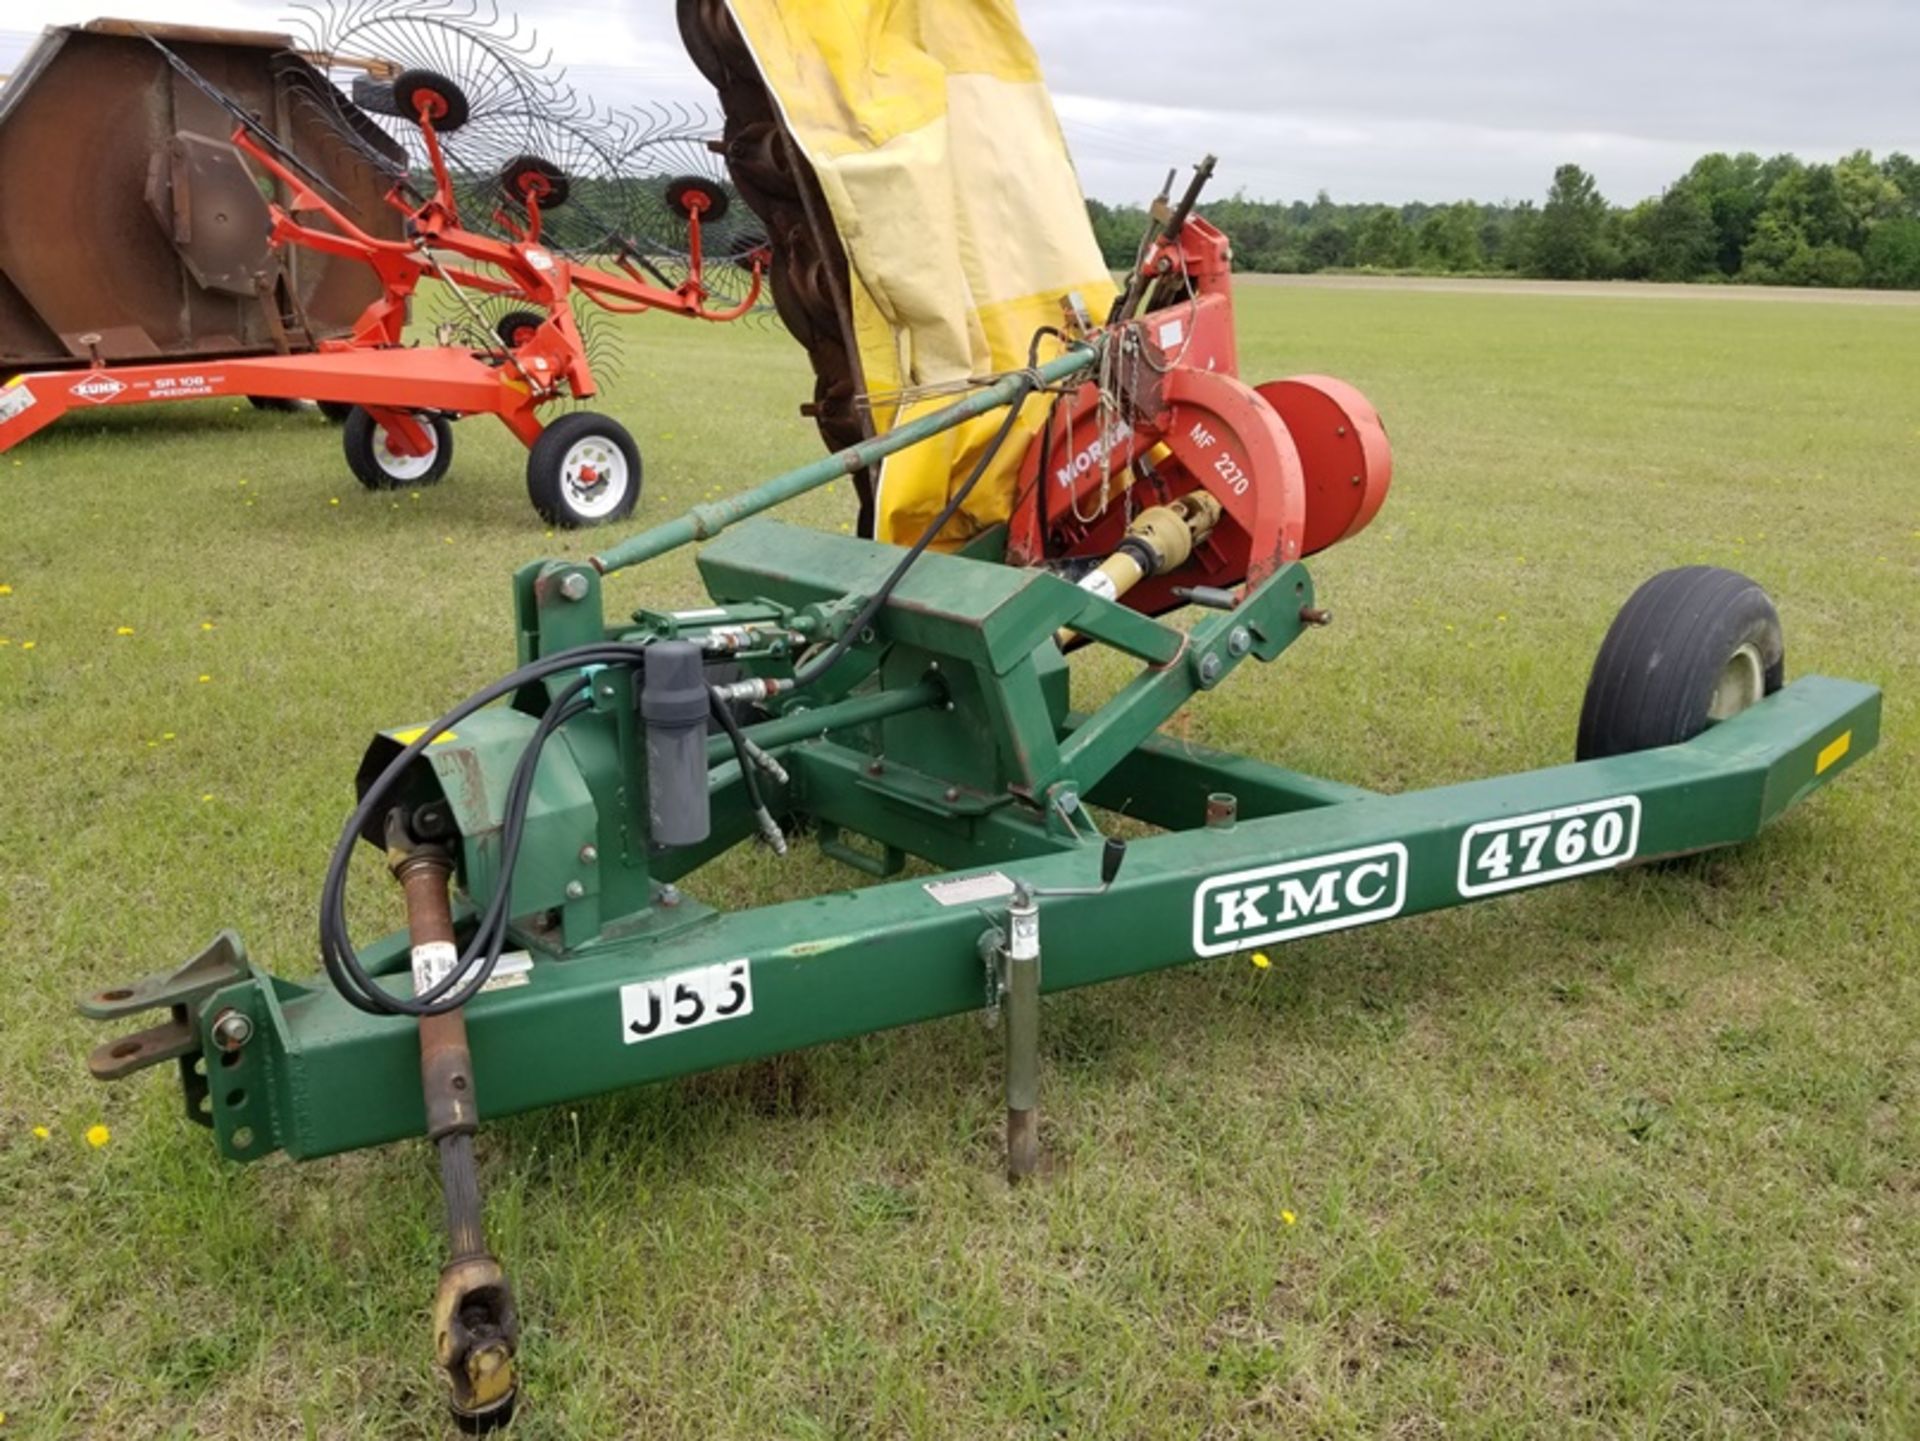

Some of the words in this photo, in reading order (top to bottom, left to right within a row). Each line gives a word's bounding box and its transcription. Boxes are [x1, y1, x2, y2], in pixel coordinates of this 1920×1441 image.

[78, 380, 120, 395] KUHN
[155, 378, 175, 388] SR
[1190, 422, 1216, 448] MF
[1214, 452, 1249, 495] 2270
[1476, 812, 1623, 880] 4760
[1214, 861, 1388, 936] KMC
